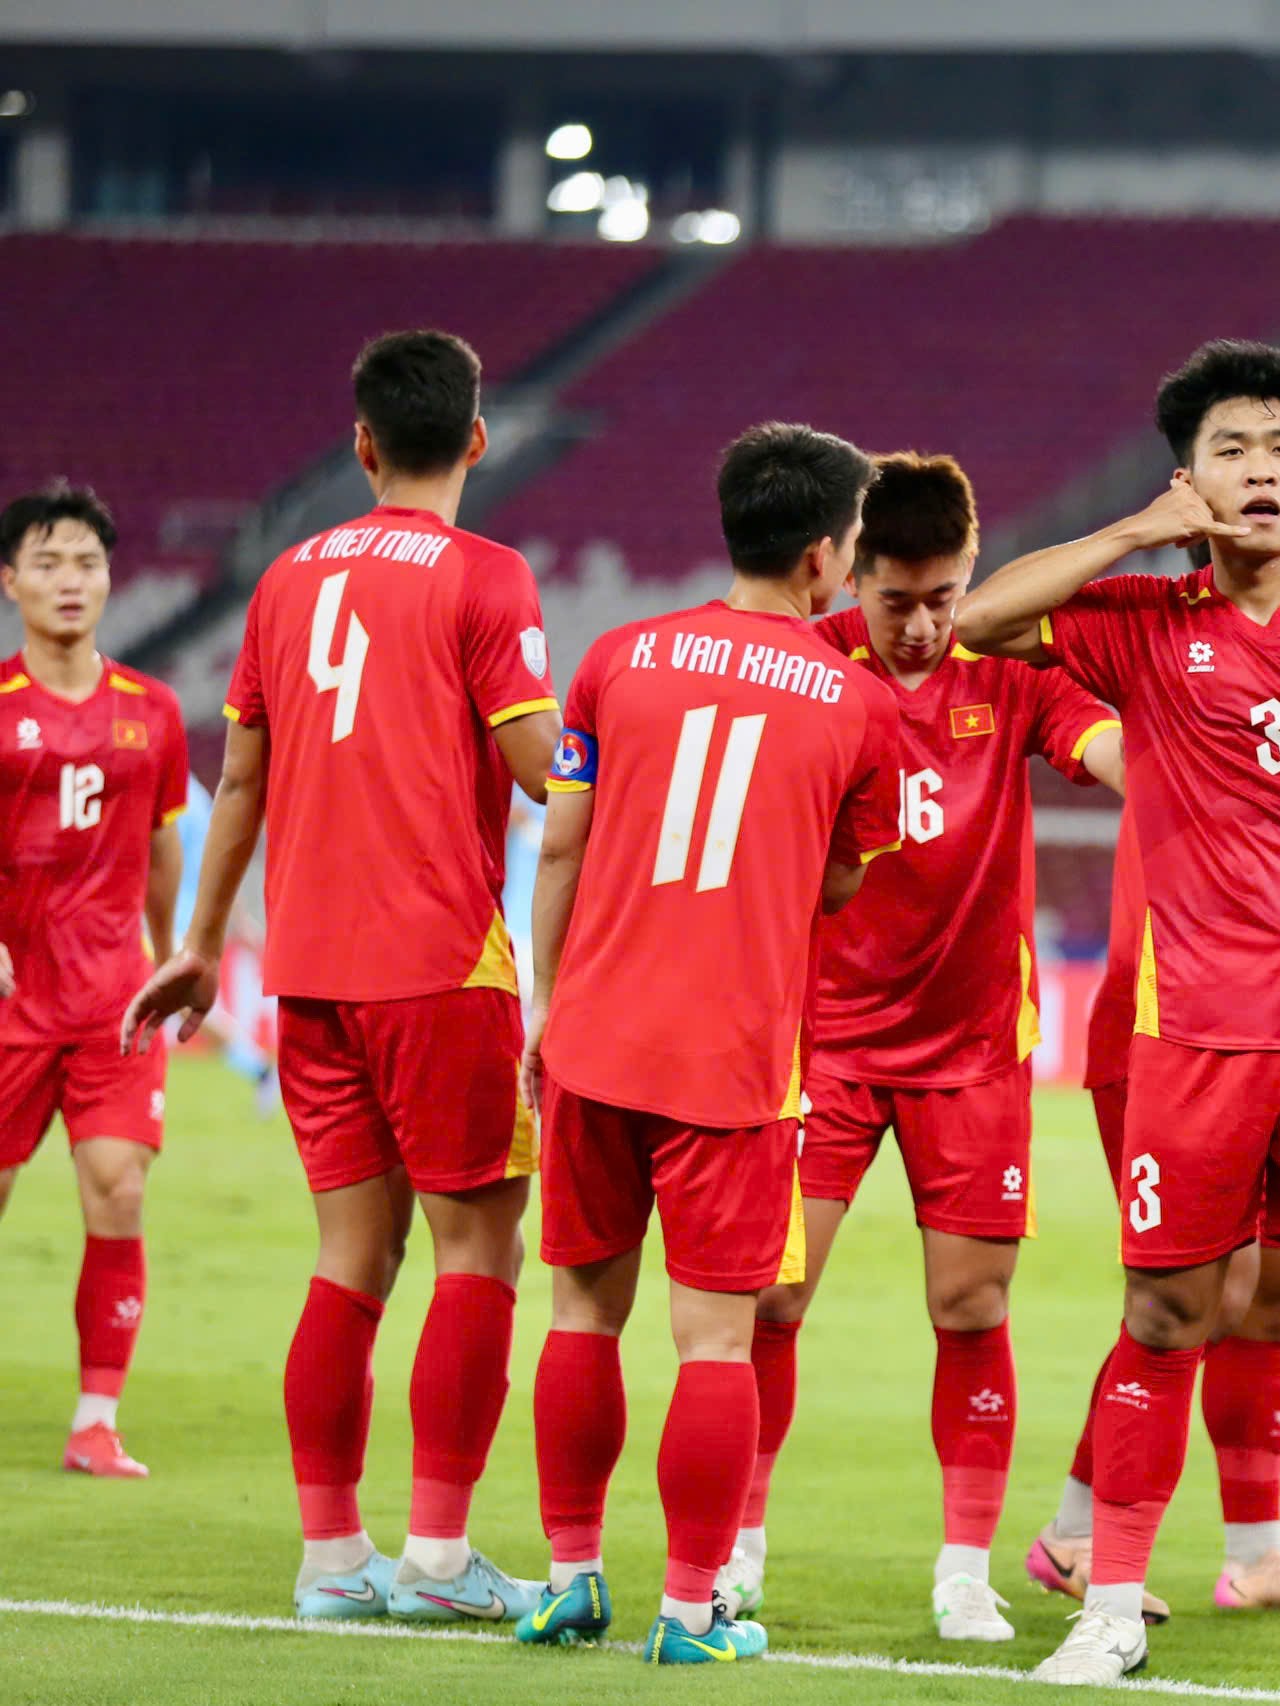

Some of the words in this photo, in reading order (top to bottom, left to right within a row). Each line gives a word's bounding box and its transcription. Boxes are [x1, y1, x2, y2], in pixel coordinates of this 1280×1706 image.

[372, 530, 451, 568] MINH
[307, 570, 370, 744] 4
[630, 632, 657, 669] K.
[671, 632, 733, 676] VAN
[737, 643, 845, 703] KHANG
[59, 763, 105, 831] 12
[651, 704, 767, 893] 11
[1129, 1152, 1162, 1234] 3
